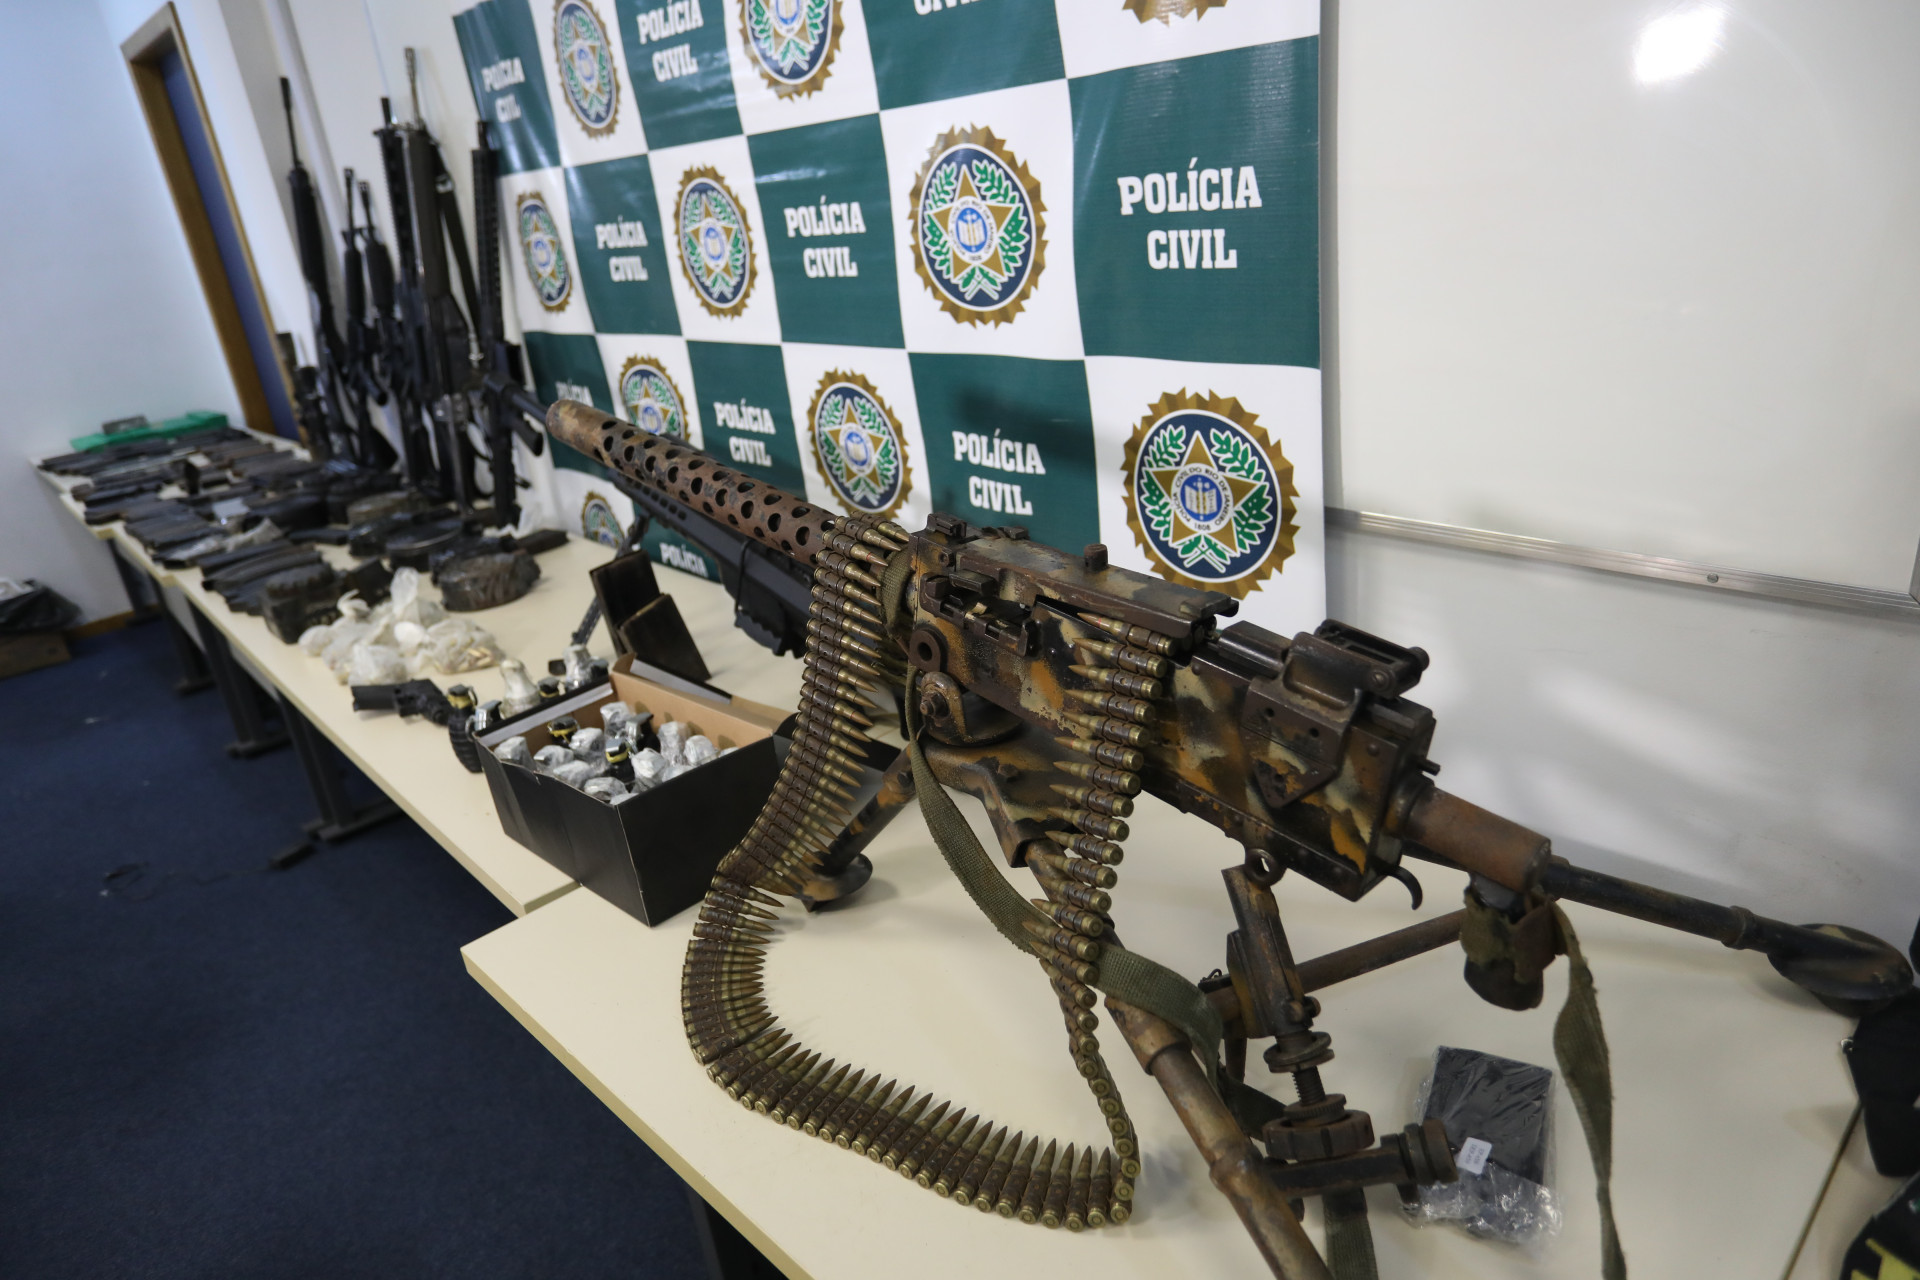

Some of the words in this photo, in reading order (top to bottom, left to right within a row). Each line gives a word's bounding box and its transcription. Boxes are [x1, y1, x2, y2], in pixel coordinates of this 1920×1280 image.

[652, 43, 698, 82] CIVIL
[1117, 157, 1262, 216] POLÍCIA
[595, 214, 648, 250] POLÍCIA
[783, 195, 866, 238] POLÍCIA
[609, 256, 649, 282] CIVIL
[803, 246, 858, 278] CIVIL
[1147, 229, 1237, 270] CIVIL
[714, 398, 776, 435] POLÍCIA
[729, 436, 772, 467] CIVIL
[952, 428, 1046, 475] POLÍCIA
[969, 476, 1033, 516] CIVIL
